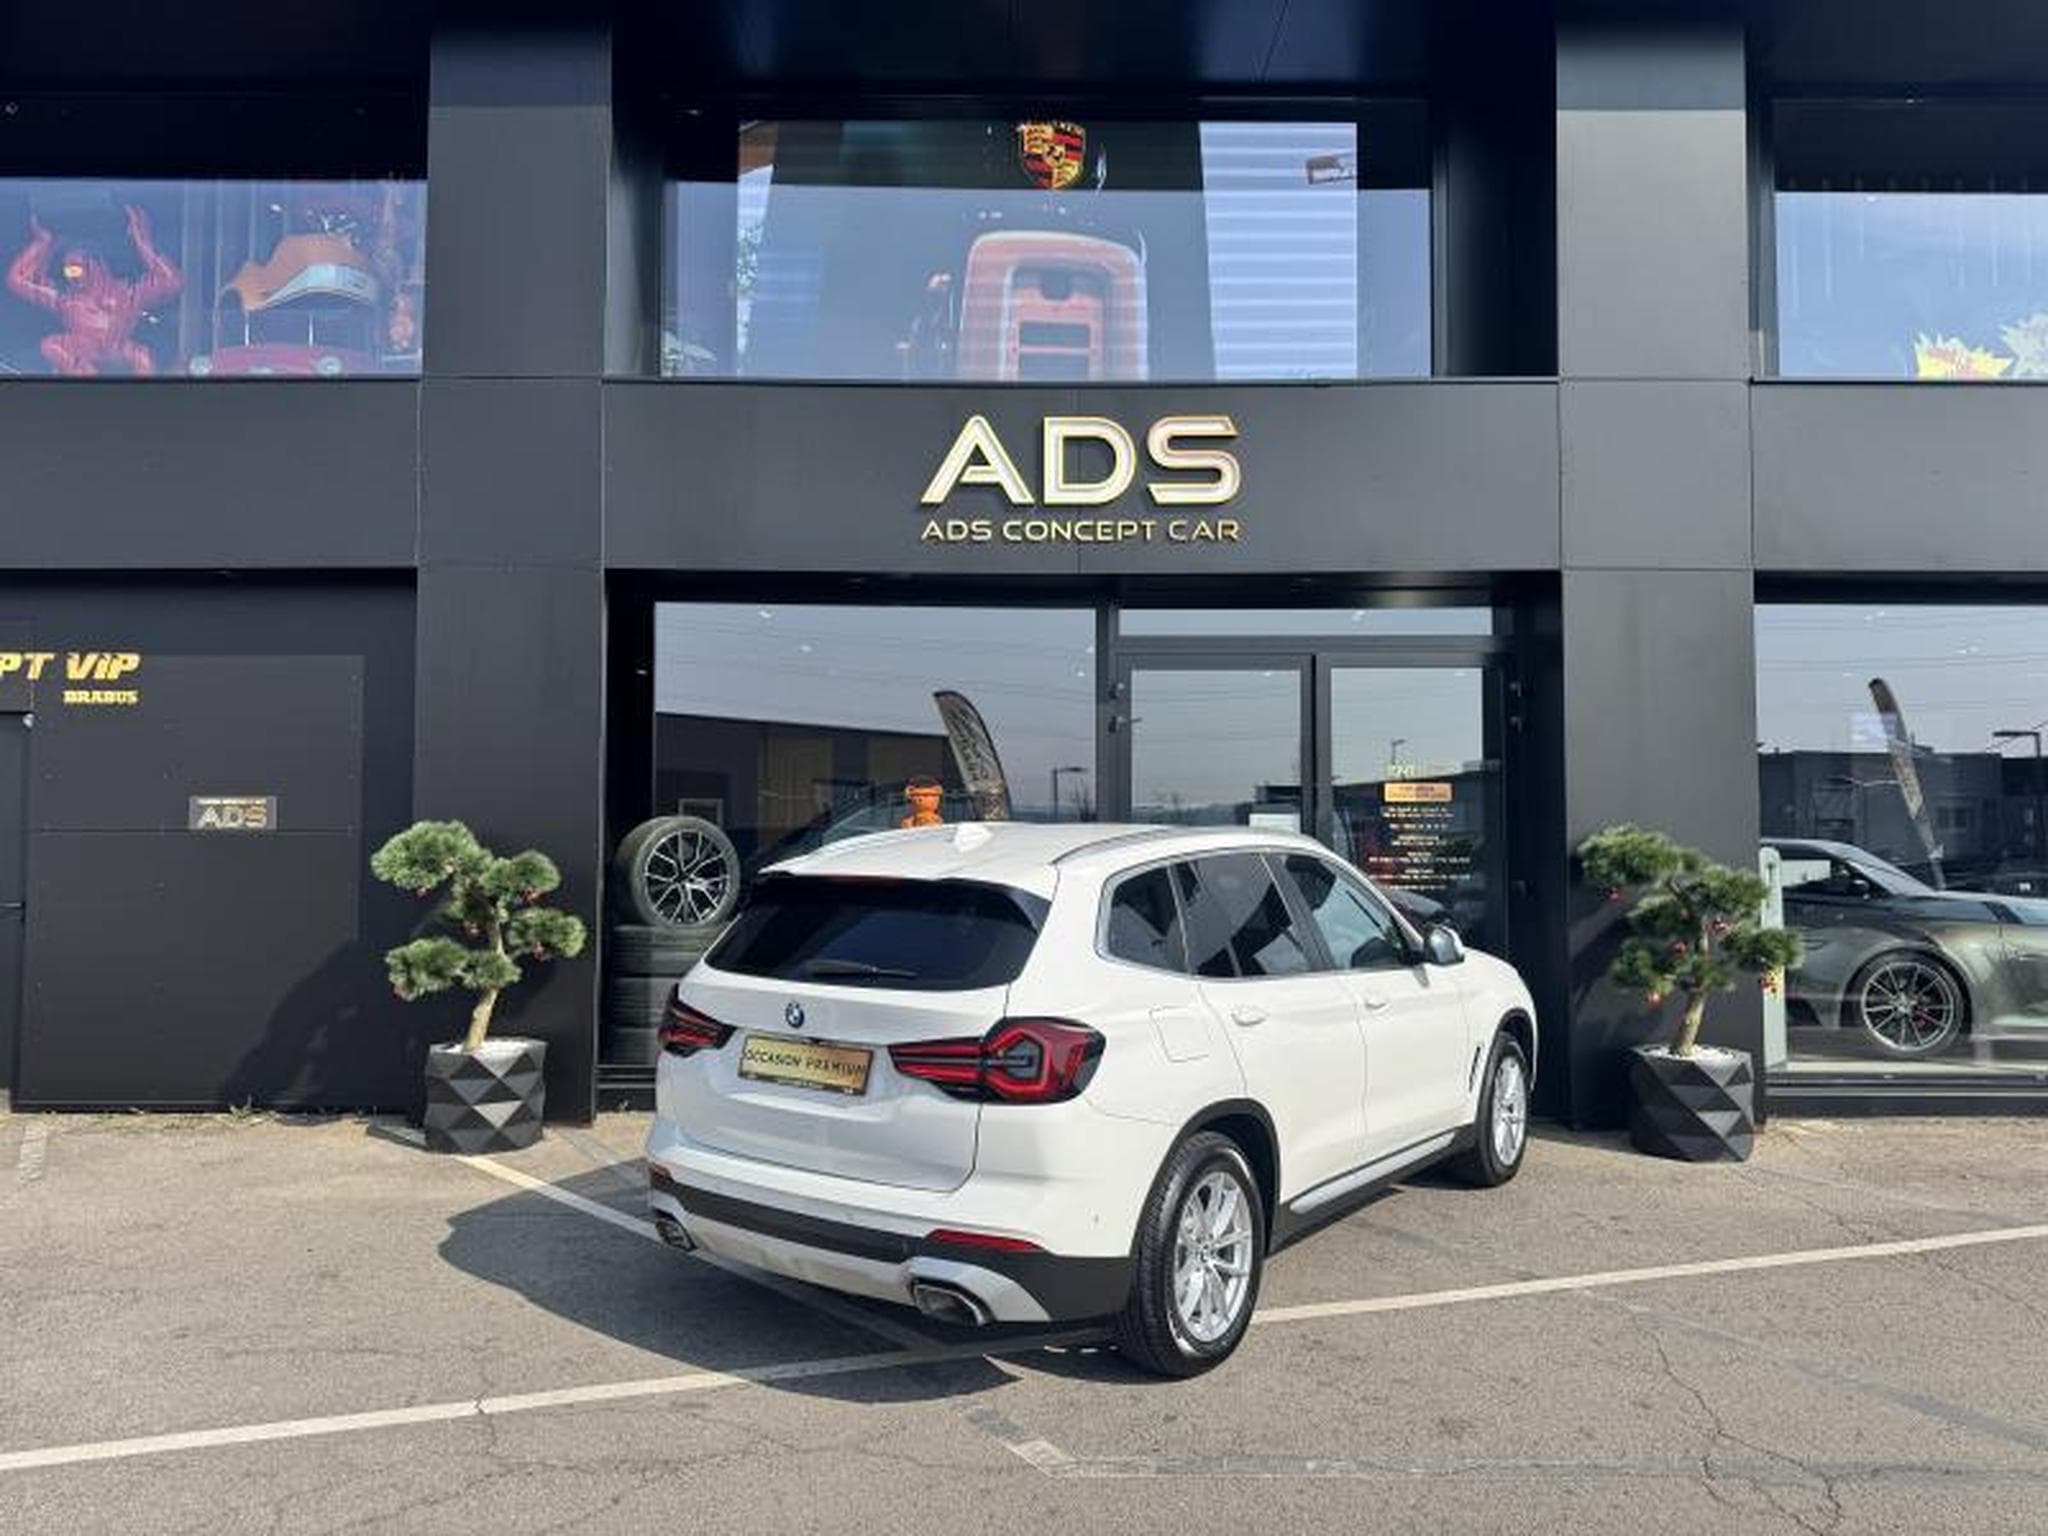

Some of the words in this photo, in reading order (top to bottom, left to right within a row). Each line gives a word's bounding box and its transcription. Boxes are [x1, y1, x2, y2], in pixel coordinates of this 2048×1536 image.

[921, 415, 1241, 504] ADS
[921, 520, 992, 541] ADS
[1002, 520, 1156, 541] CONCEPT
[1168, 520, 1240, 541] CAR
[63, 690, 139, 703] BRABUS
[197, 805, 267, 829] ADS
